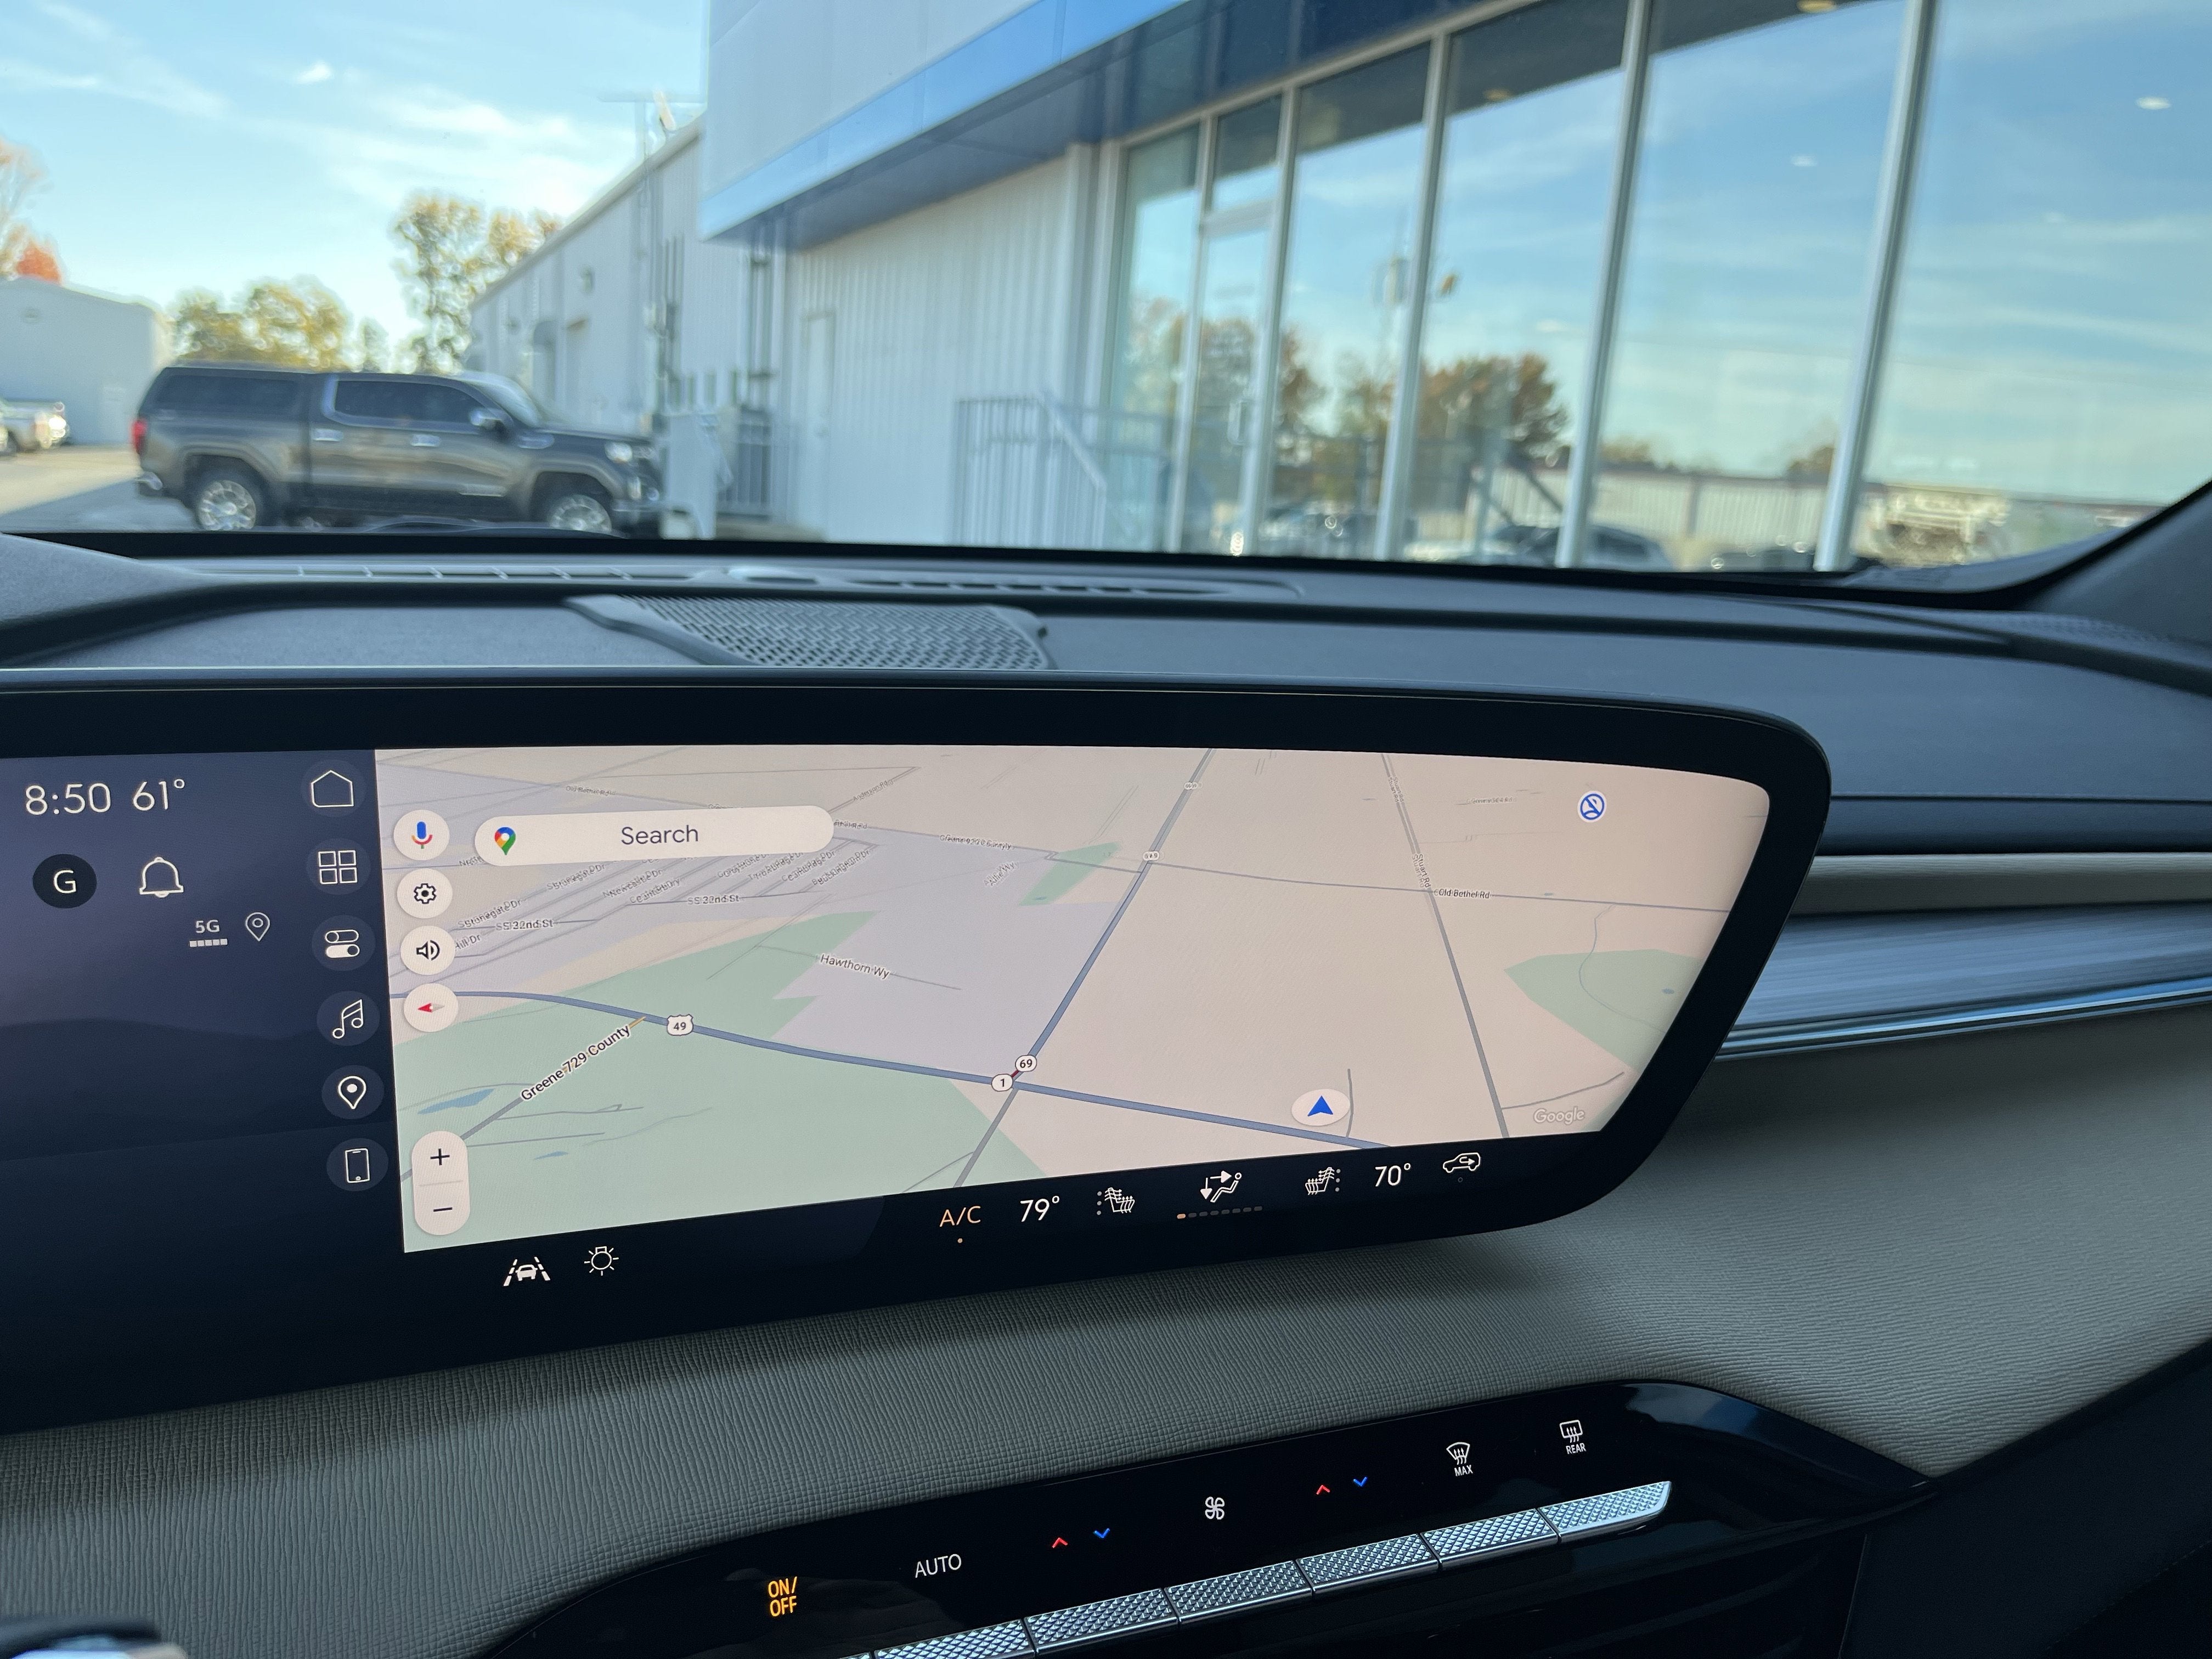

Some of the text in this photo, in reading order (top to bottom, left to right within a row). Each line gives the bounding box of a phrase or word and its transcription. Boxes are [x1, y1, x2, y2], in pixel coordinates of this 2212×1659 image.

[26, 779, 184, 815] 8:50 61°
[622, 825, 698, 844] Search
[54, 870, 76, 893] G
[1454, 889, 1477, 898] Bethel
[1480, 891, 1489, 899] Rd
[196, 920, 219, 933] 5G
[820, 954, 889, 979] Hawthorn Wy
[521, 1024, 631, 1102] Greene 729 County
[1019, 1059, 1032, 1068] 69
[1000, 1079, 1006, 1087] 1
[1533, 1106, 1584, 1125] Google
[1375, 1163, 1410, 1187] 70°
[940, 1196, 1059, 1227] A/C 79°
[1566, 1442, 1586, 1454] REAR
[1454, 1464, 1473, 1476] MAX
[916, 1554, 961, 1578] AUTO
[768, 1577, 797, 1598] ON/
[769, 1595, 797, 1617] OFF
